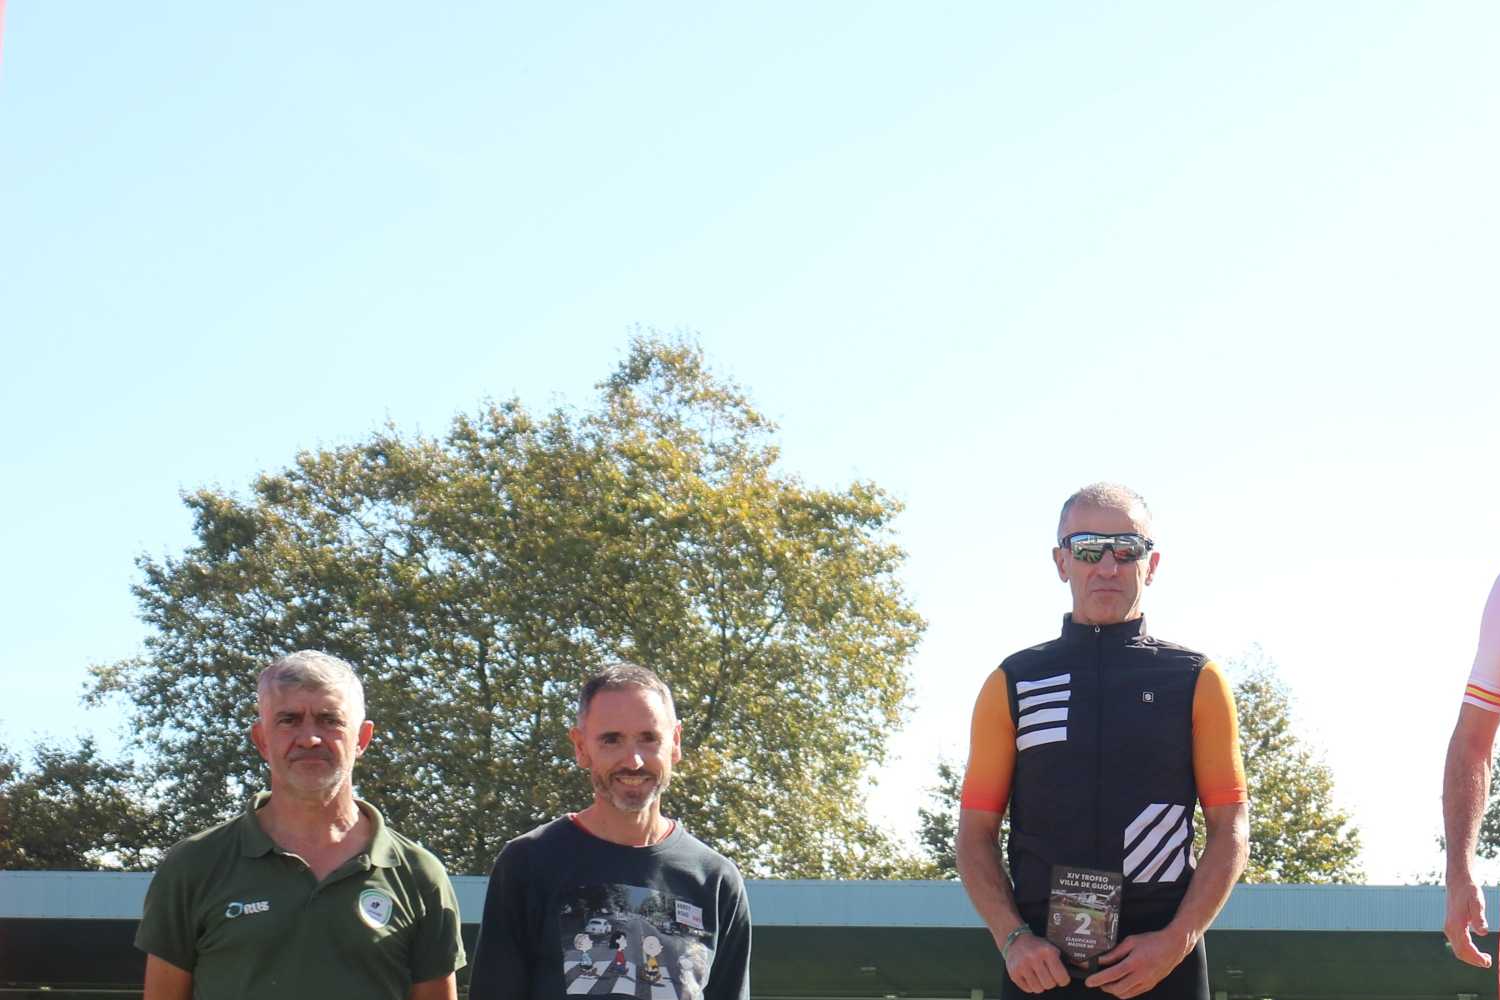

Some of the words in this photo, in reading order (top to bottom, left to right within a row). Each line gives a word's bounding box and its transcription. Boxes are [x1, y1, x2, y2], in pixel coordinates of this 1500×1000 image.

[1067, 872, 1080, 880] XIV
[1081, 874, 1109, 882] TROFEO
[1074, 912, 1092, 935] 2
